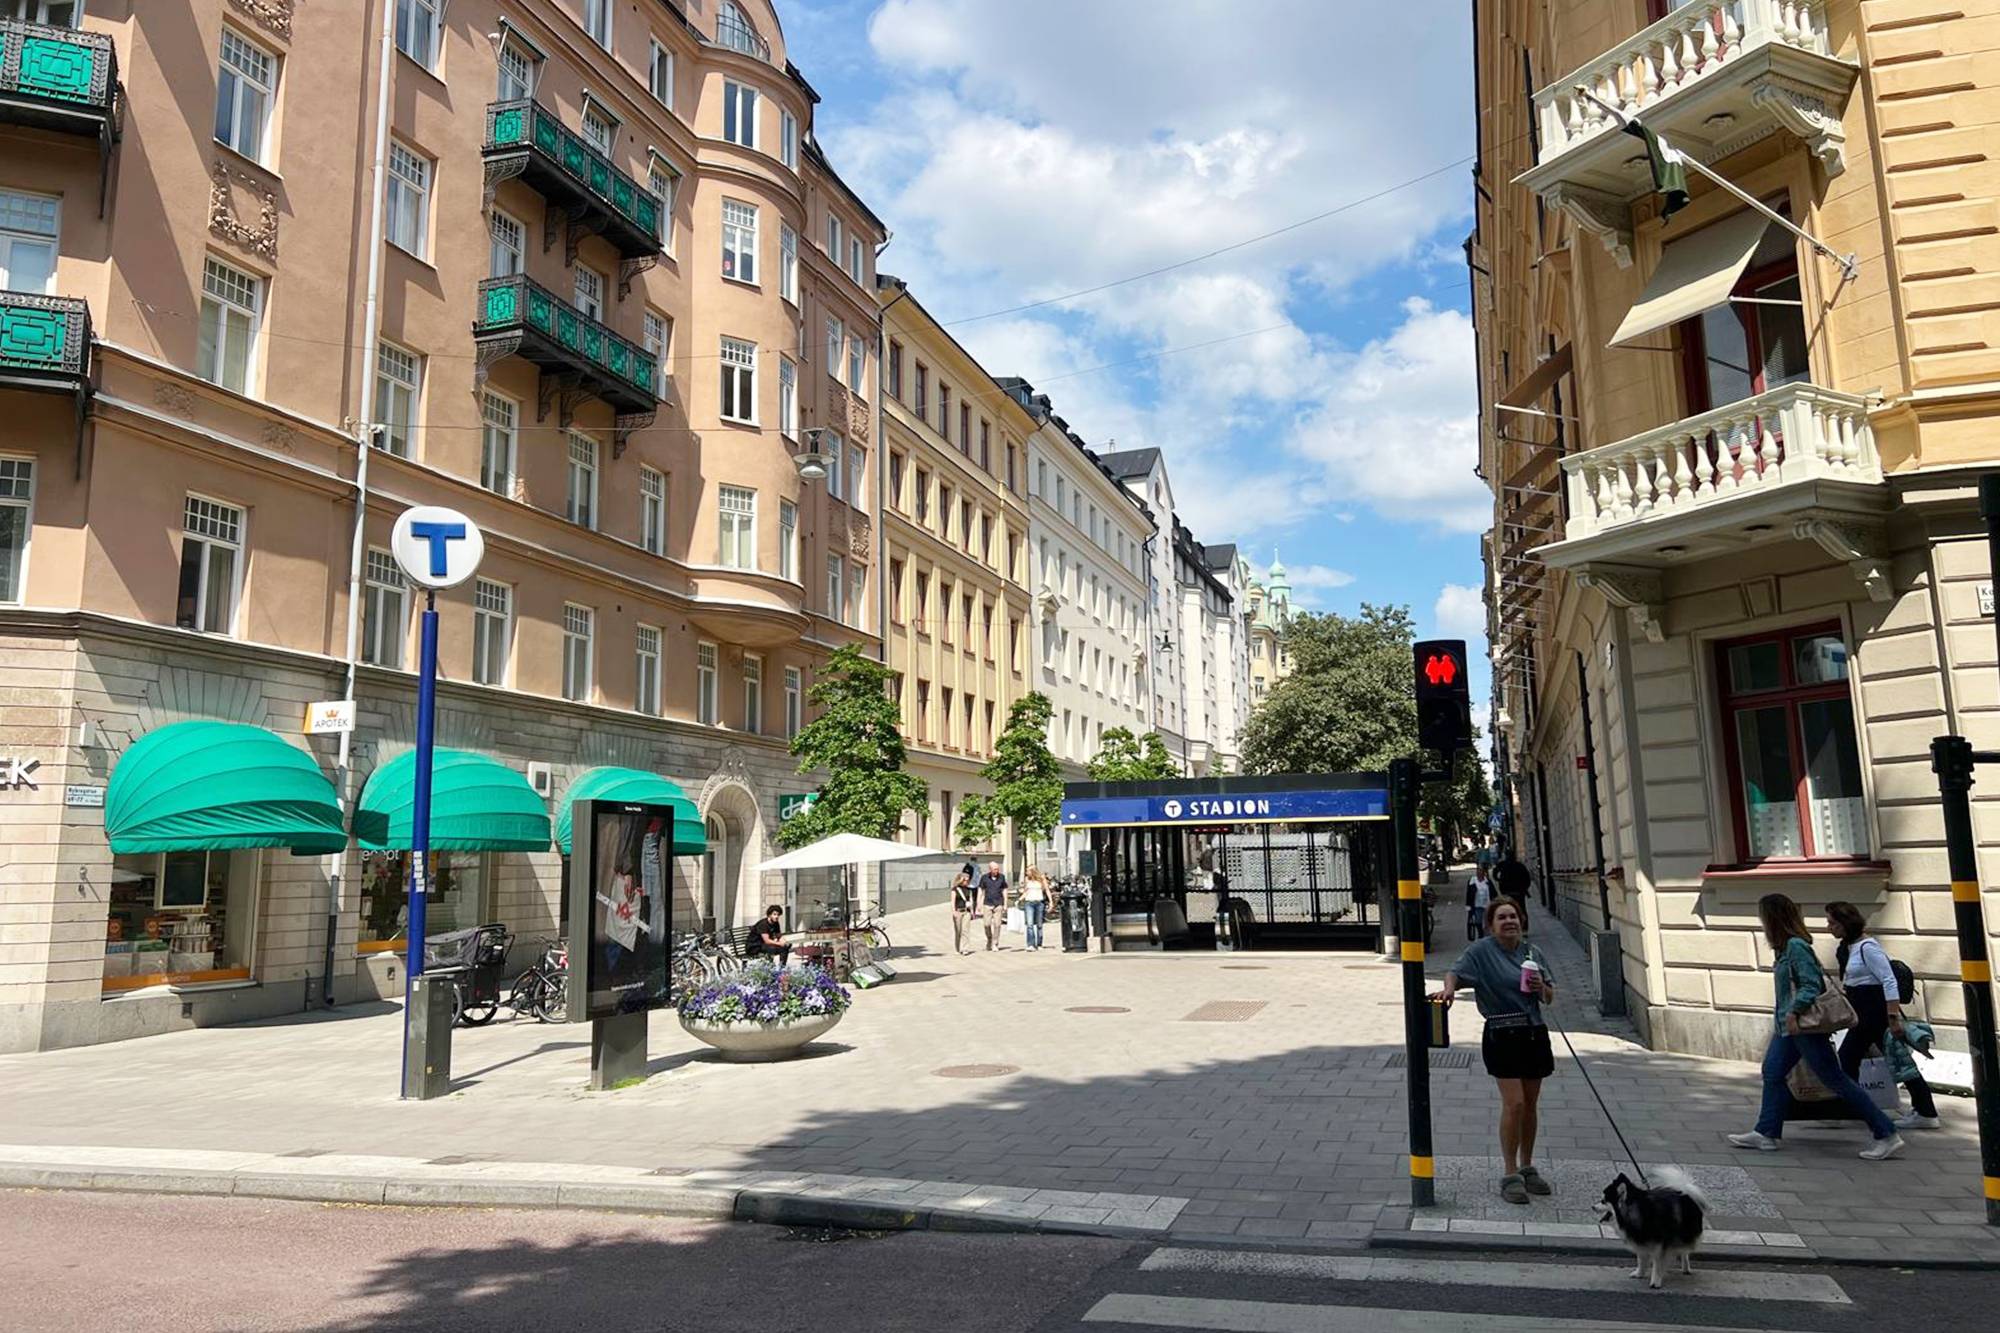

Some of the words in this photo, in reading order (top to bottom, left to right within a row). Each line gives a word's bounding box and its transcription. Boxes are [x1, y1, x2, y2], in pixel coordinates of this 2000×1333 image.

[411, 522, 466, 577] T
[314, 718, 350, 728] APOTEK
[1189, 799, 1270, 816] STADION
